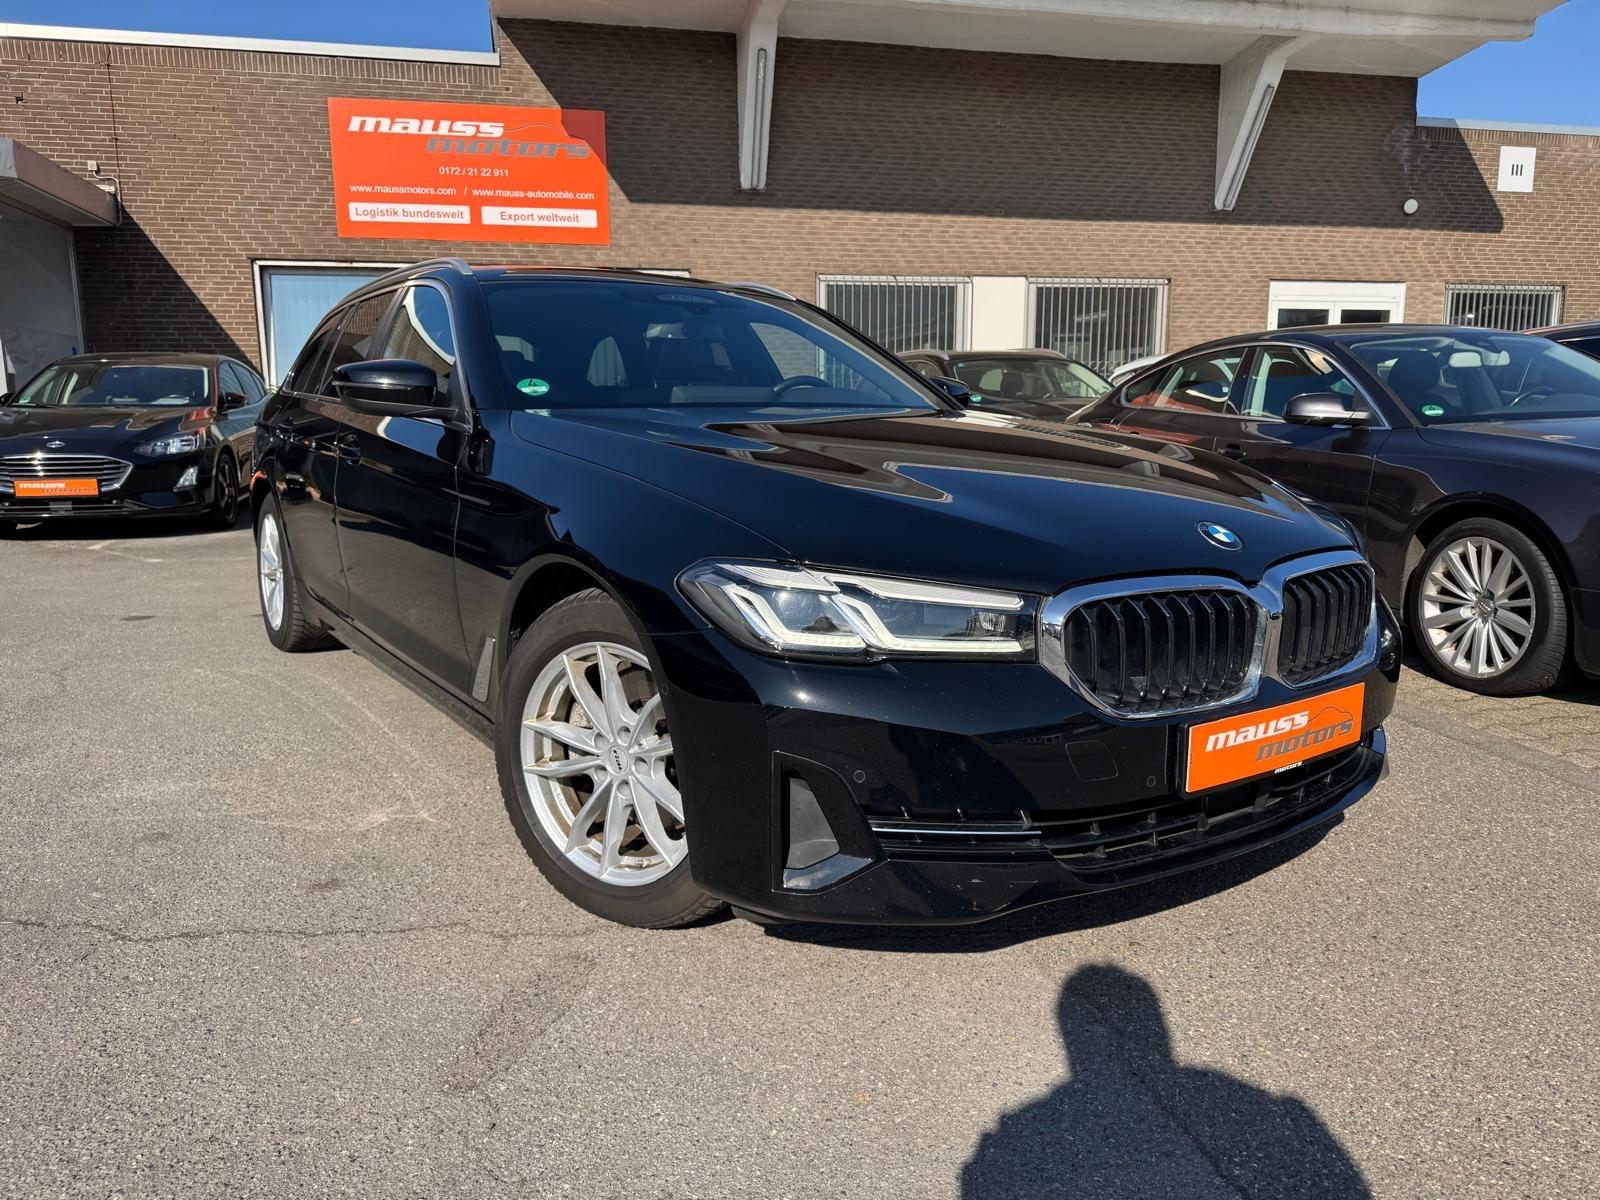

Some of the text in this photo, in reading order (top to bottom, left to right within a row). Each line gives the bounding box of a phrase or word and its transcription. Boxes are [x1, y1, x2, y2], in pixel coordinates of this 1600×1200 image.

[347, 115, 504, 137] mauss
[427, 138, 591, 159] motors
[439, 166, 461, 176] 0172
[467, 168, 478, 176] 21
[481, 168, 492, 177] 22
[493, 168, 509, 177] 911
[349, 184, 457, 196] www.maussmotors.com
[472, 188, 595, 200] www.mauss-automobile.com
[355, 207, 464, 219] Logistik bundesweit
[500, 211, 580, 223] Export weltweit
[1205, 711, 1310, 752] mauss
[1256, 719, 1353, 761] motors
